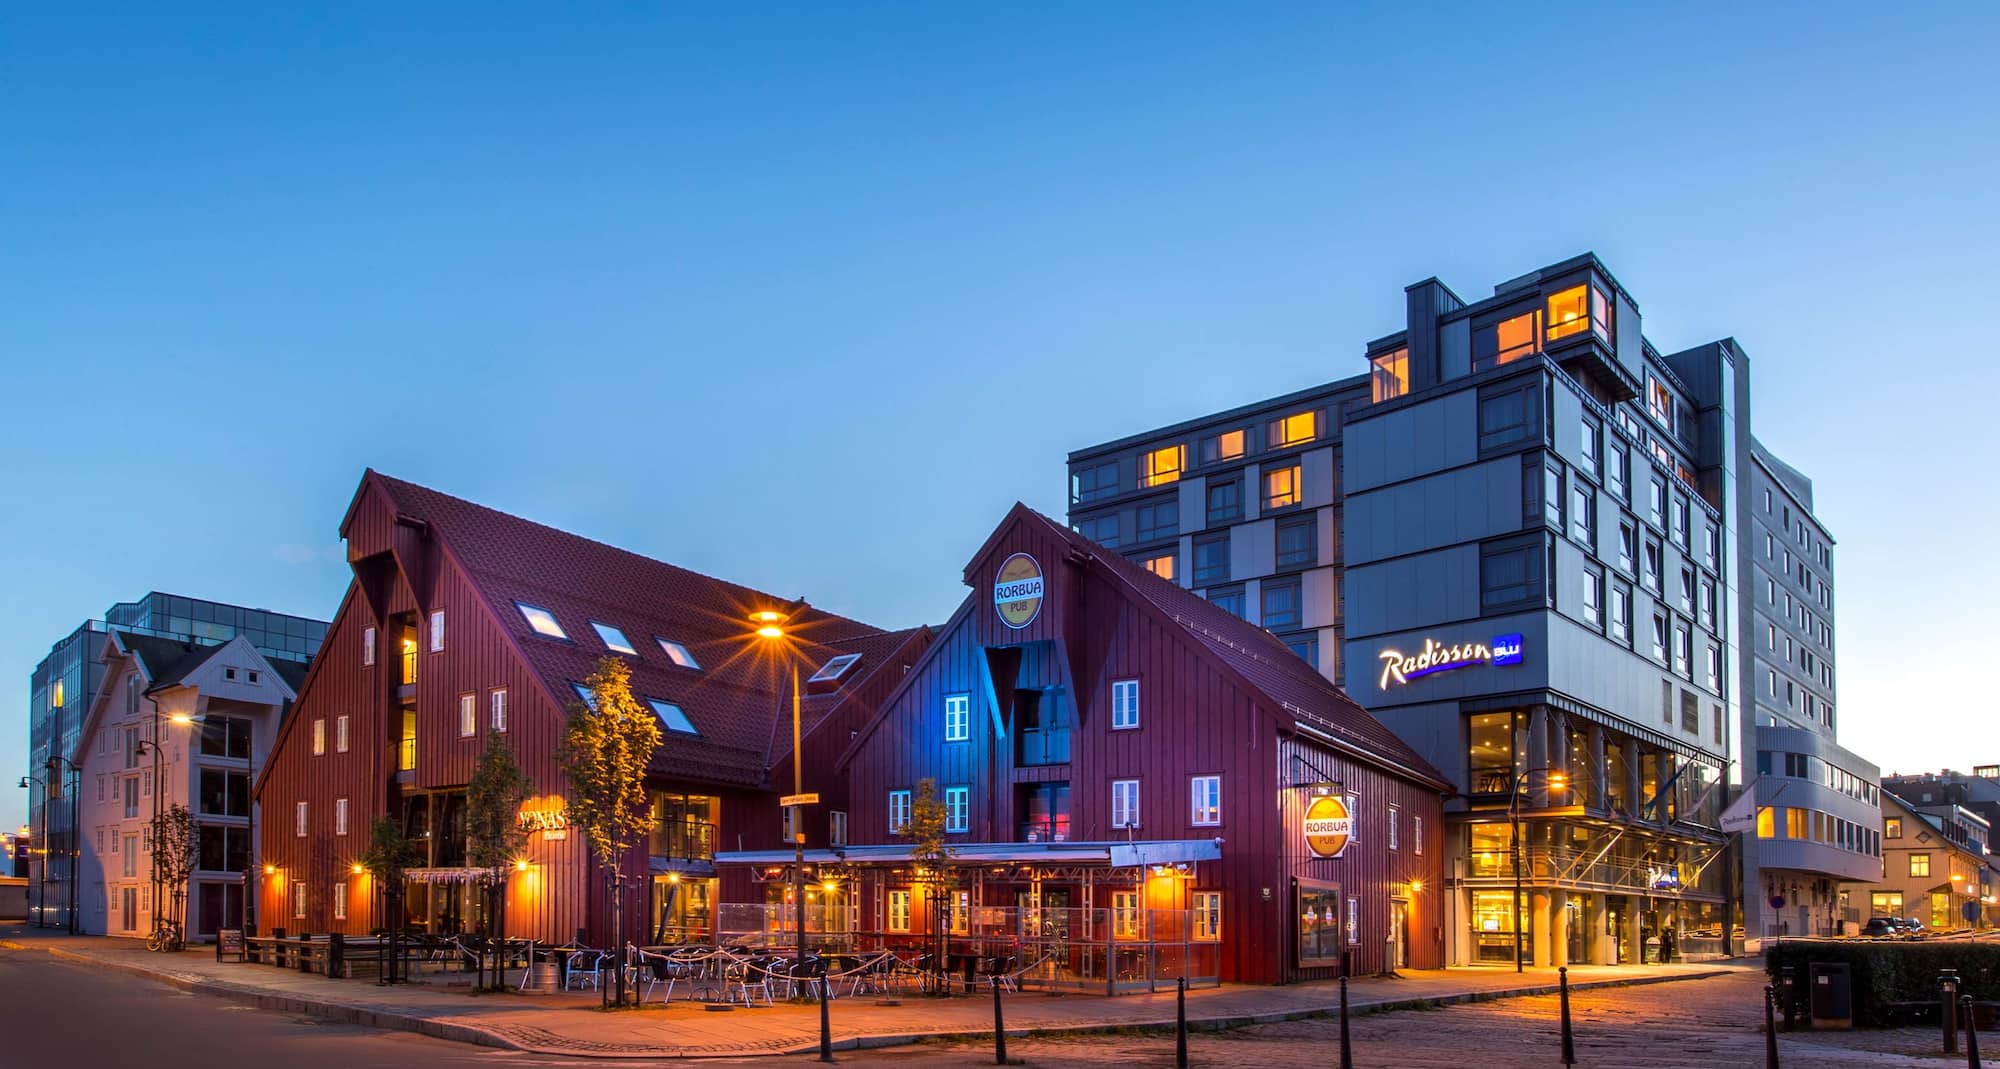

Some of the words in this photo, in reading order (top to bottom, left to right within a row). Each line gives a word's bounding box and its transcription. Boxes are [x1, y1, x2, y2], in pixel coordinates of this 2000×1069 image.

[997, 582, 1041, 599] RORBUA
[1010, 601, 1028, 612] PUB
[1379, 638, 1491, 691] Radisson
[1493, 645, 1519, 657] BLU
[519, 810, 566, 830] YONAS
[1306, 821, 1348, 833] RORBUA
[1319, 836, 1335, 845] PUB
